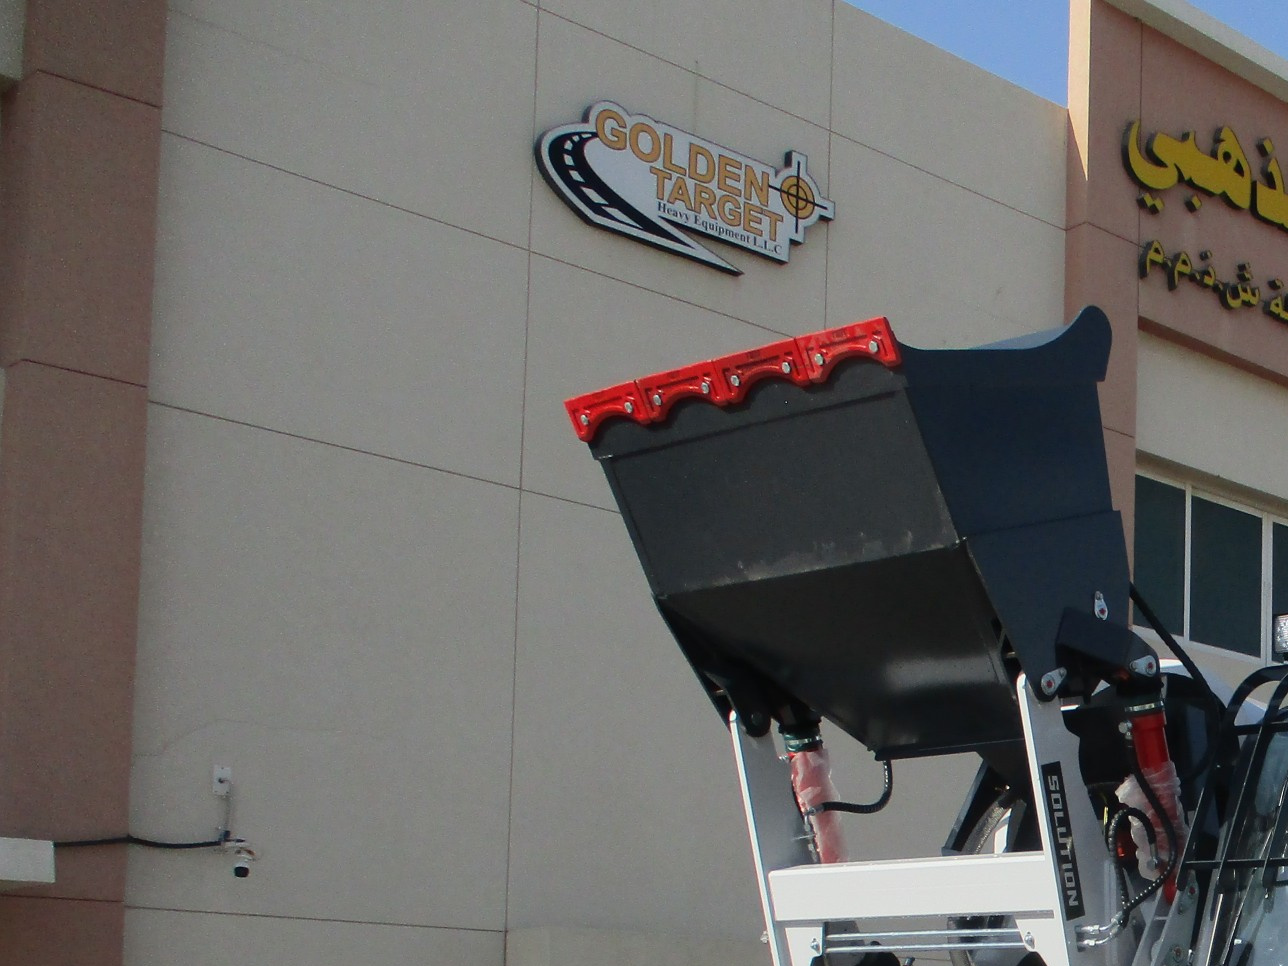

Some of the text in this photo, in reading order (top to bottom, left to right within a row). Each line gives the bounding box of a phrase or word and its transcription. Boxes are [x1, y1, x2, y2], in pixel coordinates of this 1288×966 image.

[595, 108, 770, 206] GOLDEN
[650, 167, 784, 242] TARGET
[657, 201, 690, 223] Heavy
[694, 214, 751, 243] Equipment
[1047, 774, 1079, 907] SOLUTION
